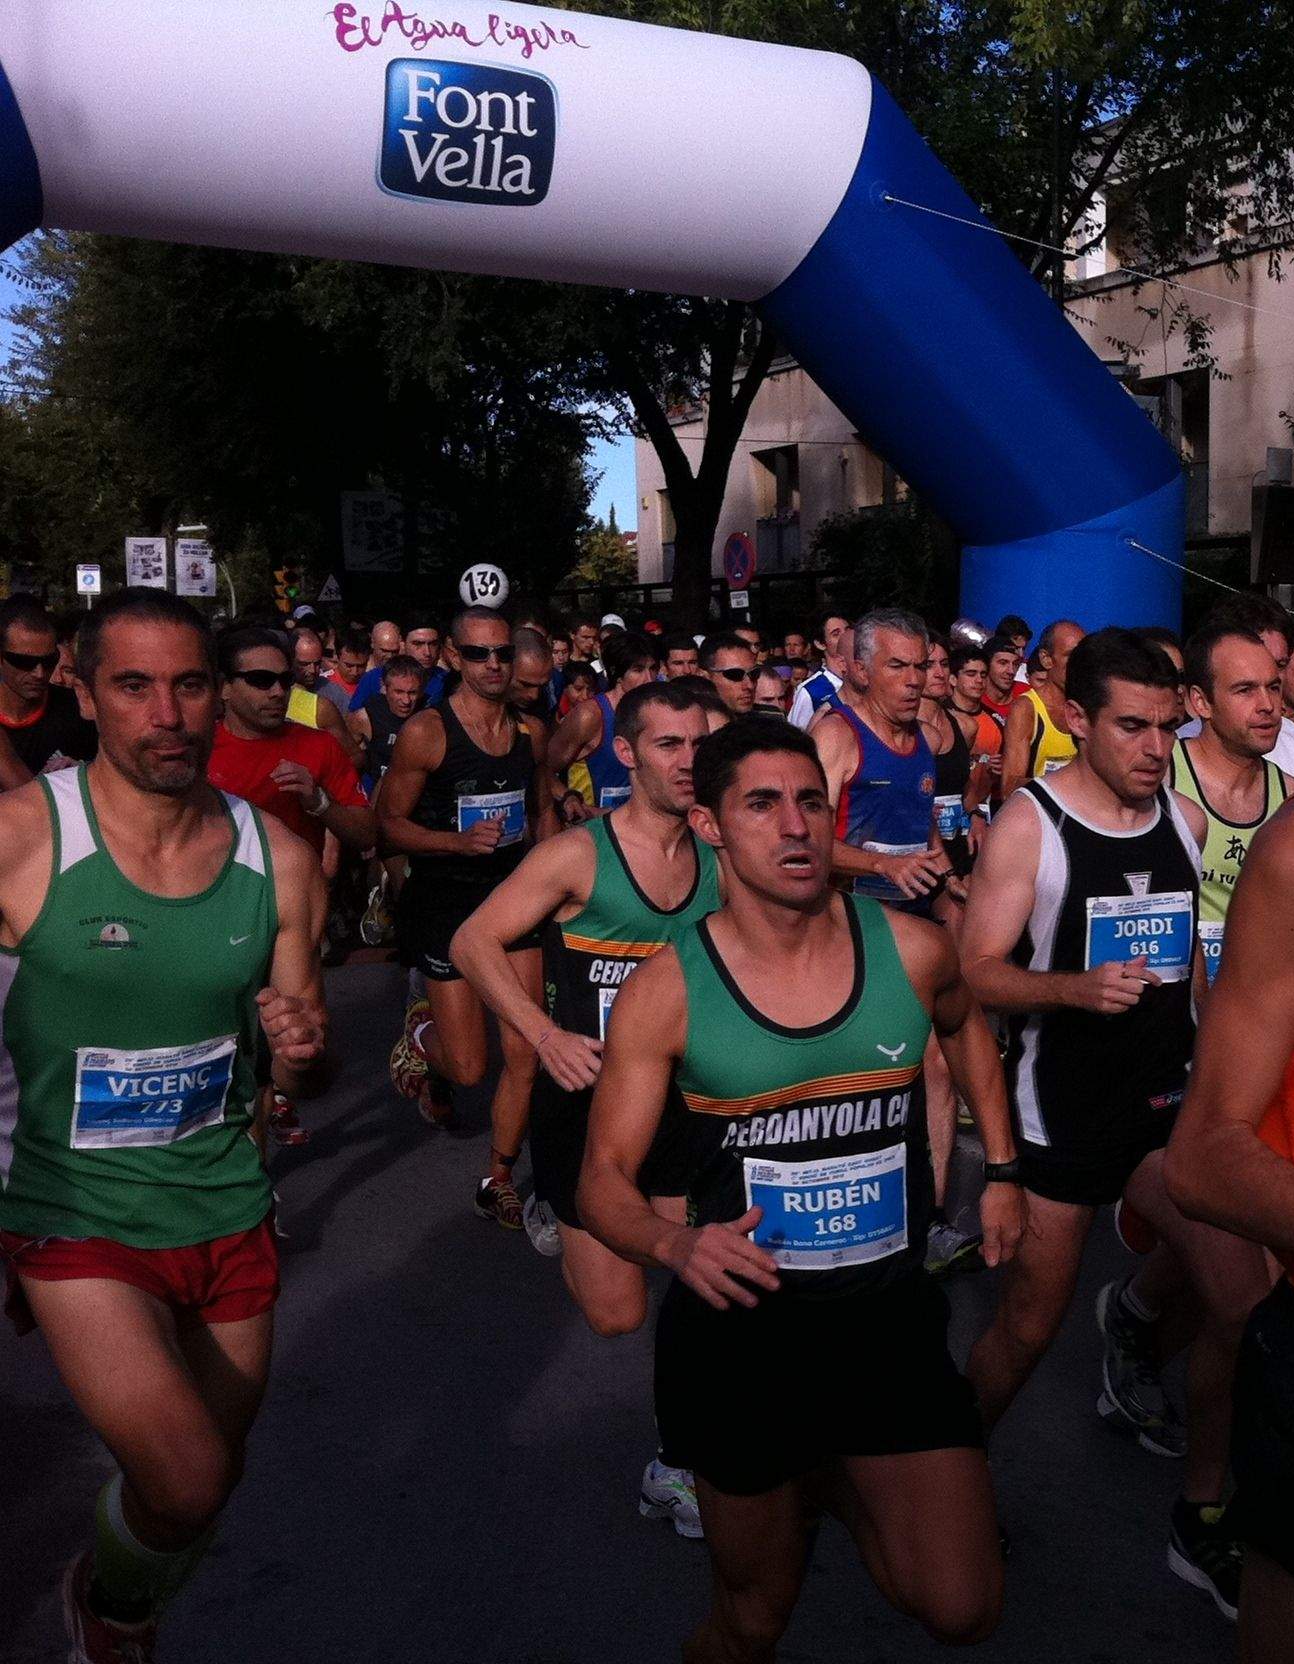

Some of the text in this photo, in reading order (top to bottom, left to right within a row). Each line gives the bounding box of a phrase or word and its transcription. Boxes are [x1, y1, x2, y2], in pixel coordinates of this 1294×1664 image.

[327, 0, 590, 59] El Agua ligera
[403, 69, 538, 138] Font
[399, 129, 535, 195] Vella
[1114, 918, 1174, 938] JORDI
[1129, 940, 1160, 956] 616
[108, 1067, 212, 1097] VICENÇ
[140, 1099, 184, 1113] 773
[721, 1098, 882, 1150] CERDANYOLA
[783, 1179, 881, 1213] RUBÉN
[815, 1214, 857, 1235] 168
